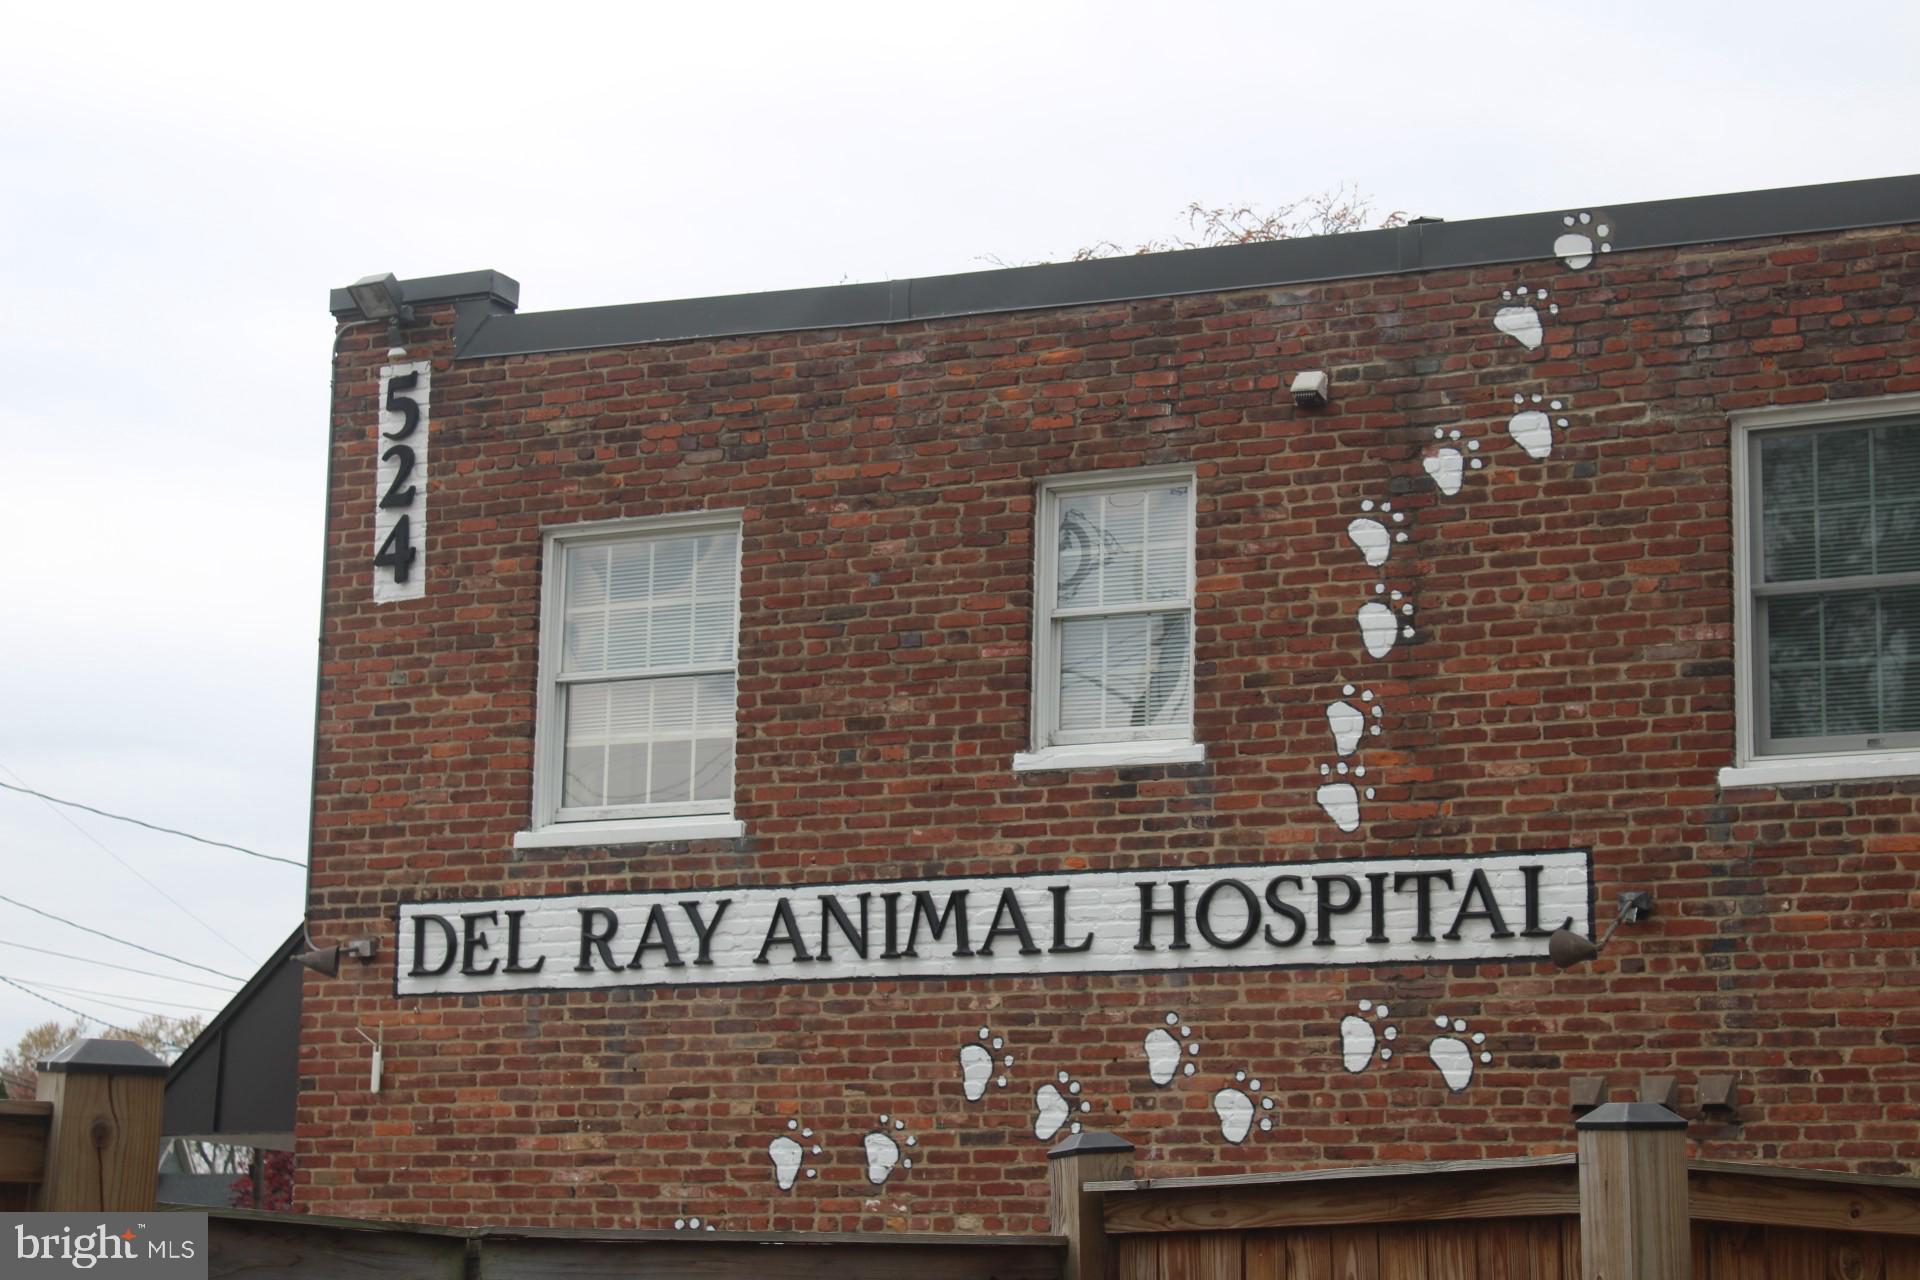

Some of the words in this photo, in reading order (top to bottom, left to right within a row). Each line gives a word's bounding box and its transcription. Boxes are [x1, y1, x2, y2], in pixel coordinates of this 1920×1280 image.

[373, 370, 420, 584] 524
[407, 909, 546, 977] DEL
[573, 897, 732, 973] RAY
[752, 885, 1095, 966] ANIMAL
[1133, 865, 1574, 951] HOSPITAL
